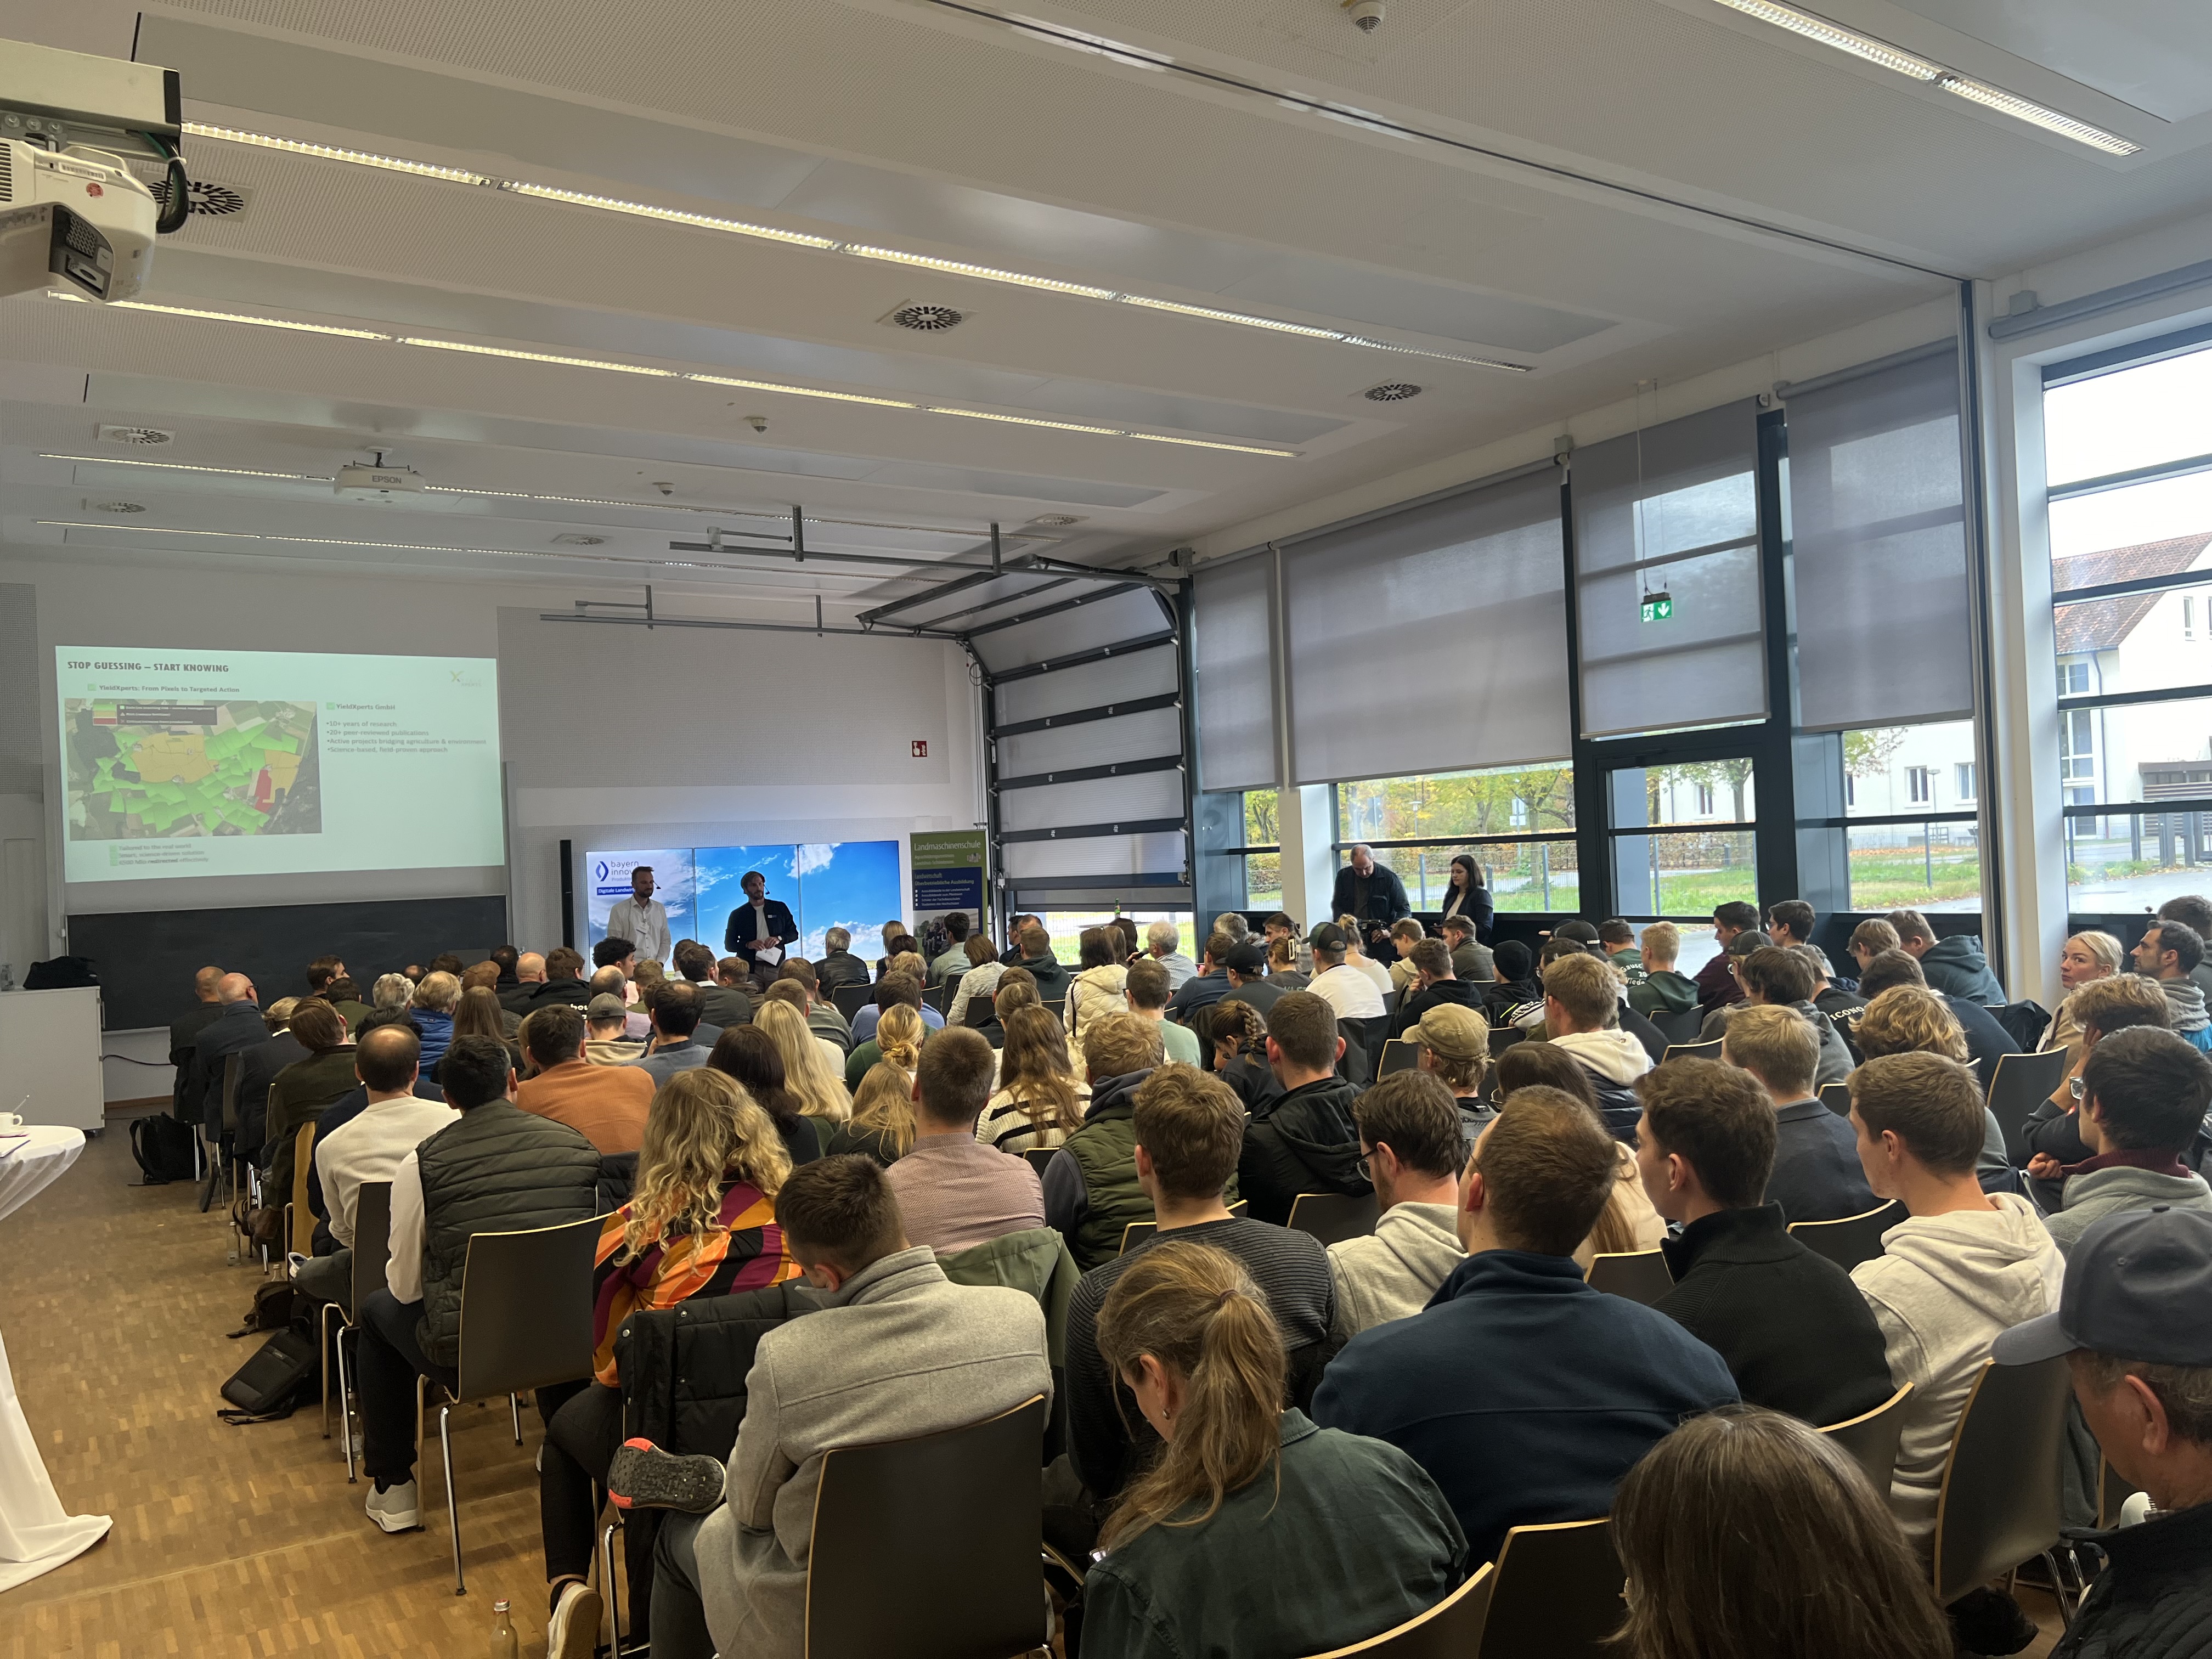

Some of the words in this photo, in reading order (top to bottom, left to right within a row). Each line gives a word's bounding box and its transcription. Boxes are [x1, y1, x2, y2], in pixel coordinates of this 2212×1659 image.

[372, 475, 402, 484] EPSON
[914, 840, 981, 851] Landmaschinenschule
[611, 860, 639, 868] bayern
[1620, 962, 1644, 973] Gausc
[1830, 1006, 1865, 1021] ICONO
